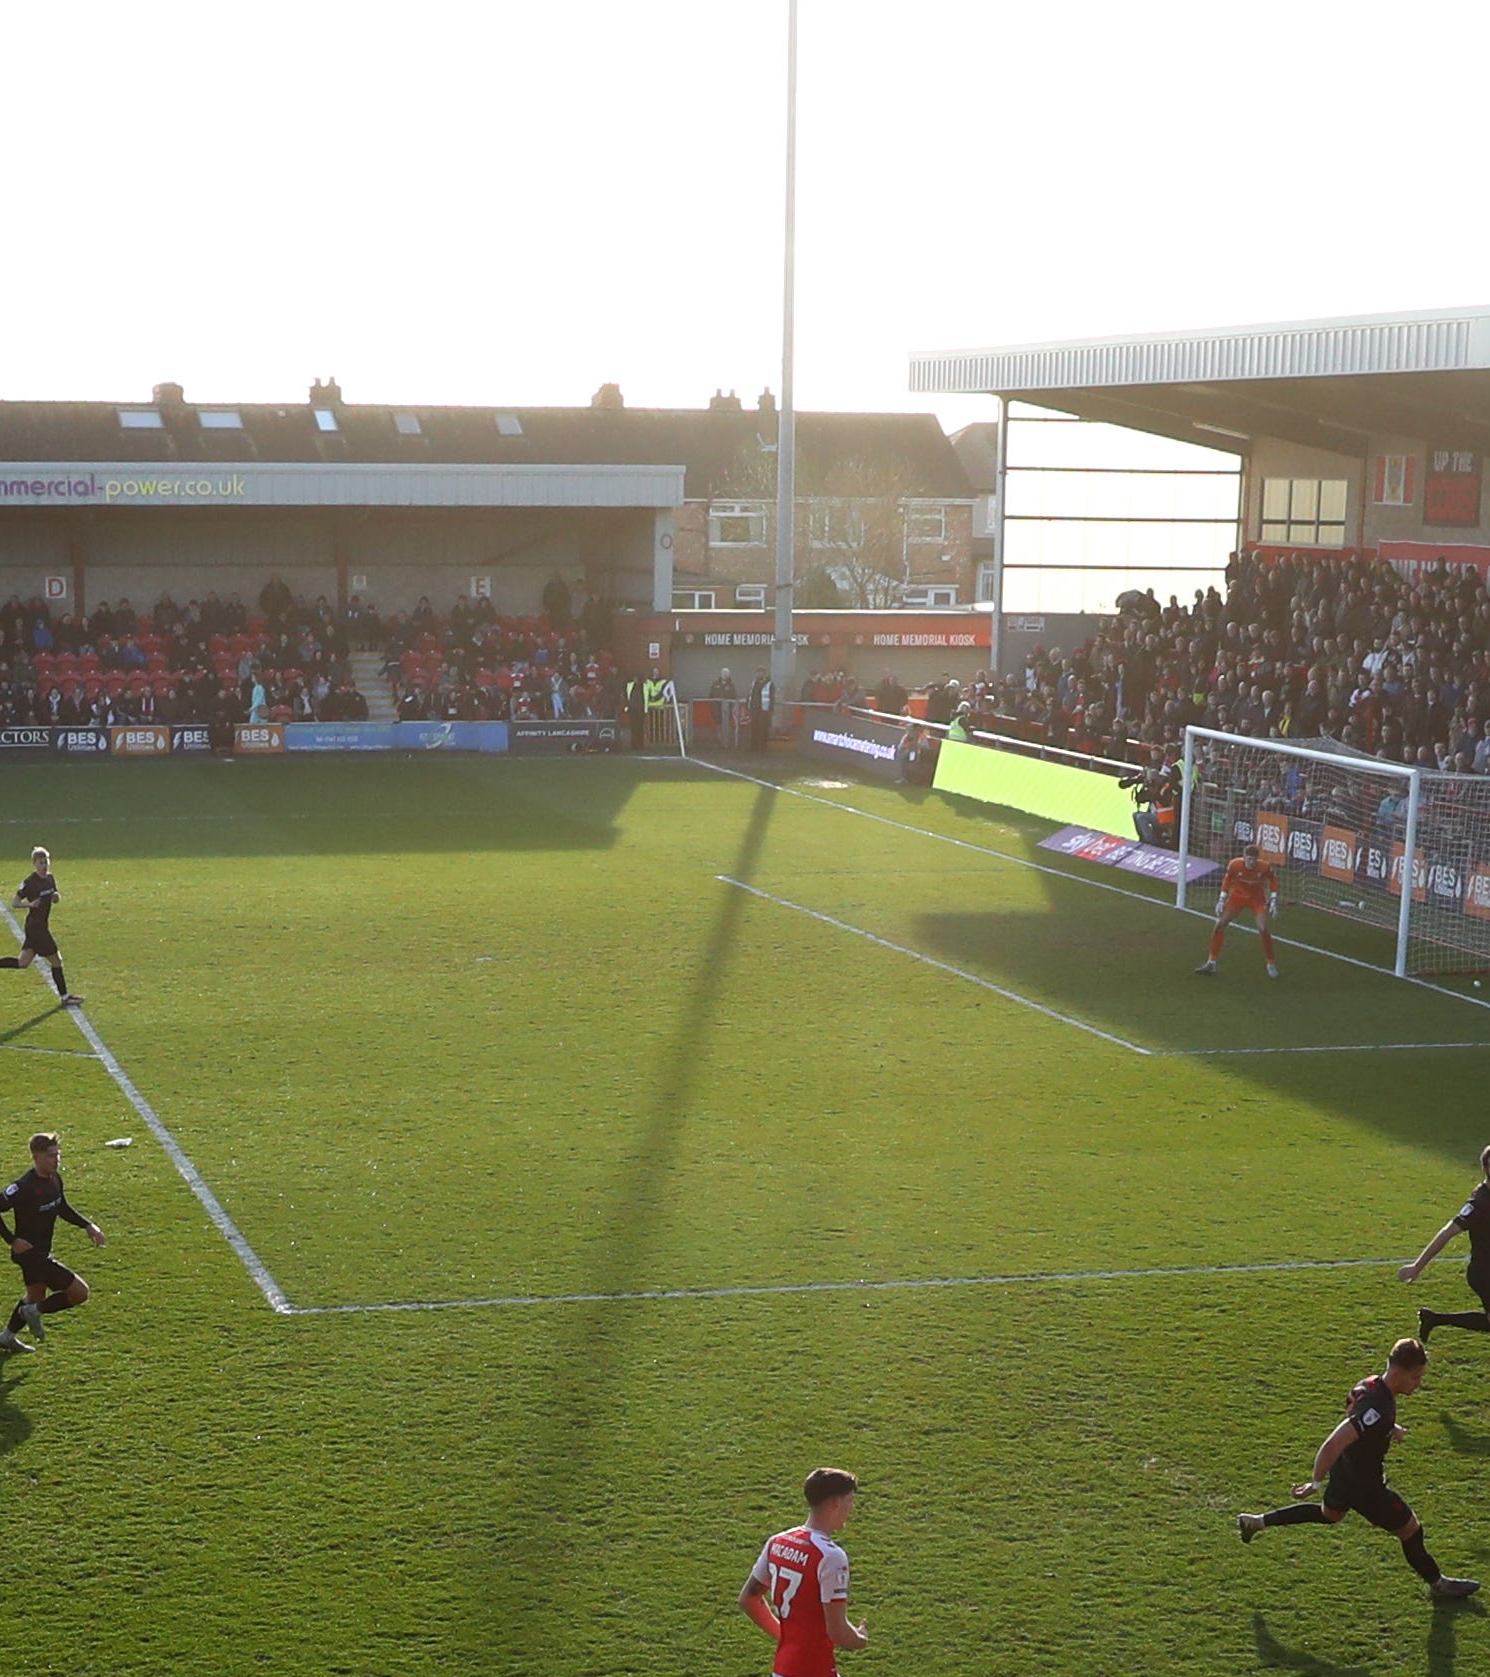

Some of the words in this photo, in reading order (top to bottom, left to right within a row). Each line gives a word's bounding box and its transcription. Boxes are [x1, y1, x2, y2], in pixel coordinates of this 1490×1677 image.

[705, 633, 731, 646] HOME
[873, 634, 898, 646] HOME
[901, 634, 947, 646] MEMORIAL
[949, 634, 975, 646] KIOSK
[67, 732, 96, 744] BES
[126, 732, 155, 744] BES
[241, 729, 269, 741] BES
[1263, 824, 1280, 843] BES
[1294, 831, 1312, 850] BES
[1329, 839, 1347, 858] BES
[1435, 865, 1456, 887] BES
